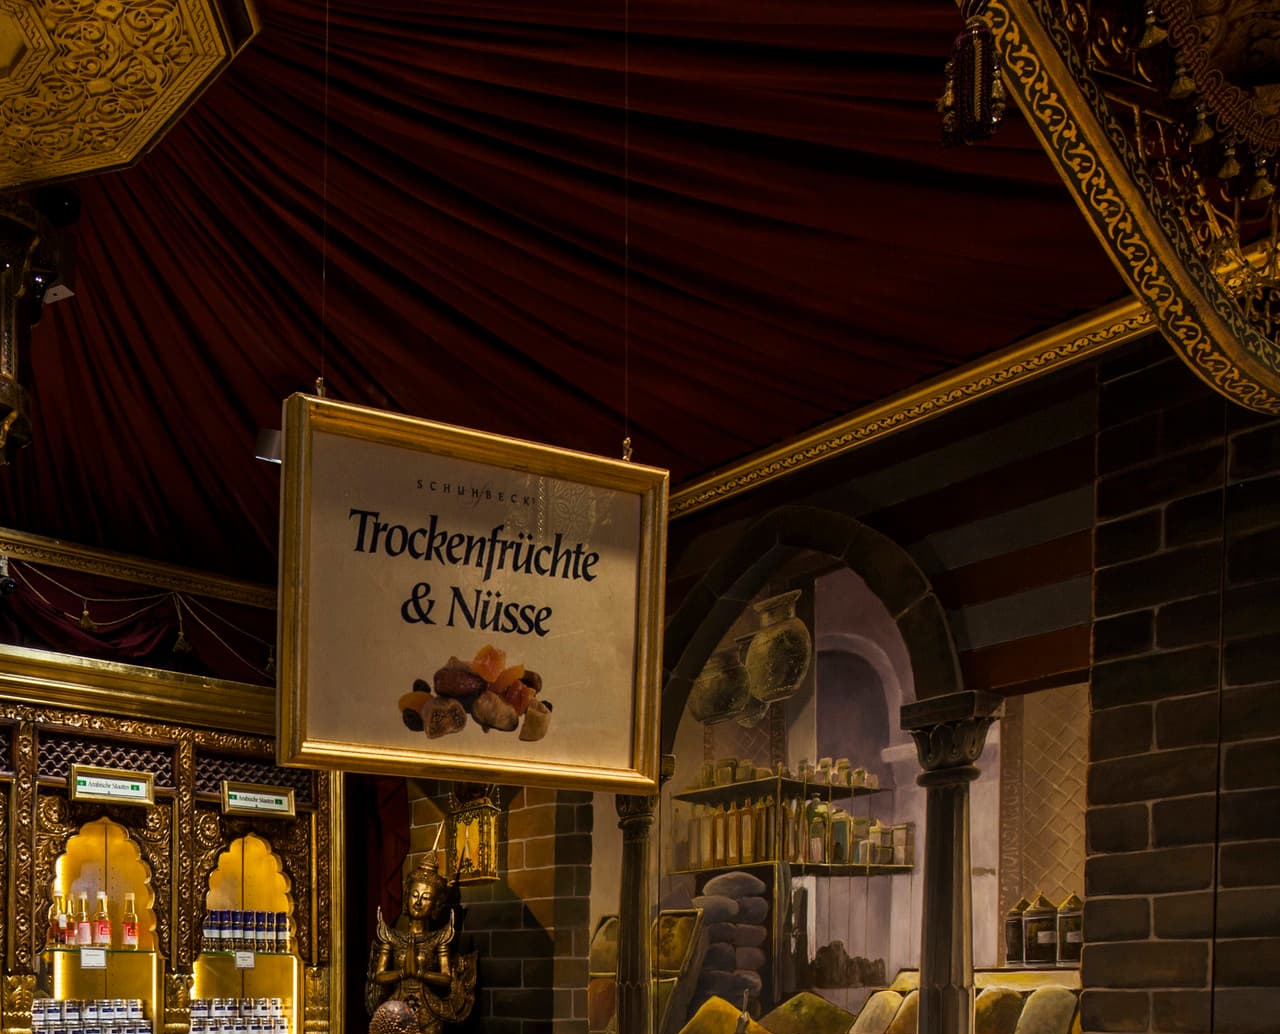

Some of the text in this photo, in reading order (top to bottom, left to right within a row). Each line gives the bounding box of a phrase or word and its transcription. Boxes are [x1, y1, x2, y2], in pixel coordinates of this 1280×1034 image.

[349, 508, 599, 582] Trockenfrüchte
[401, 582, 552, 637] & Nüsse
